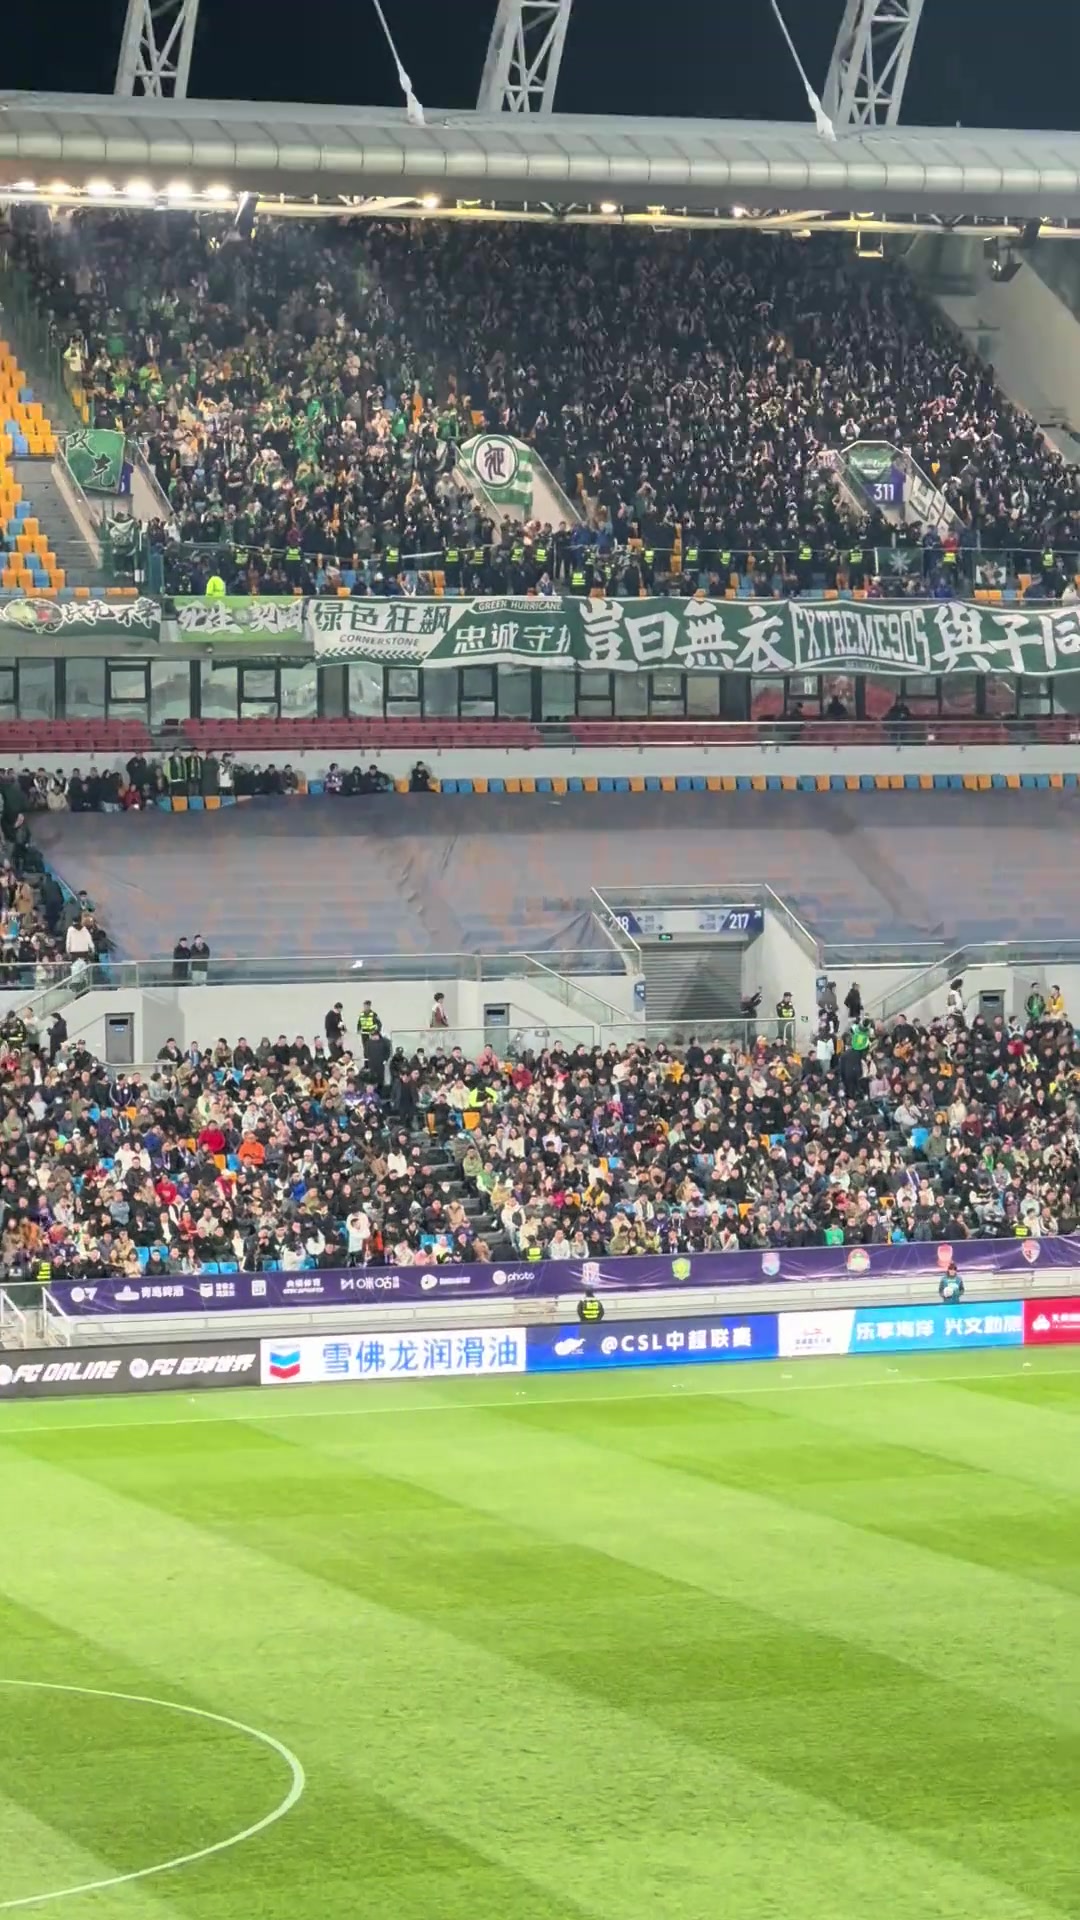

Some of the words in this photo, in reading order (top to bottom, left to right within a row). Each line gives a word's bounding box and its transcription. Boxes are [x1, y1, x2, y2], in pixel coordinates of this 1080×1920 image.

[873, 483, 895, 501] 311
[478, 600, 507, 611] GREEN
[510, 600, 562, 611] HURRICANE
[314, 602, 452, 635] 绿色狂飙
[339, 634, 420, 648] CORNERSTONE
[729, 913, 749, 929] 217
[322, 1333, 518, 1374] 雪佛龙润滑油
[41, 1360, 122, 1381] ONLINE
